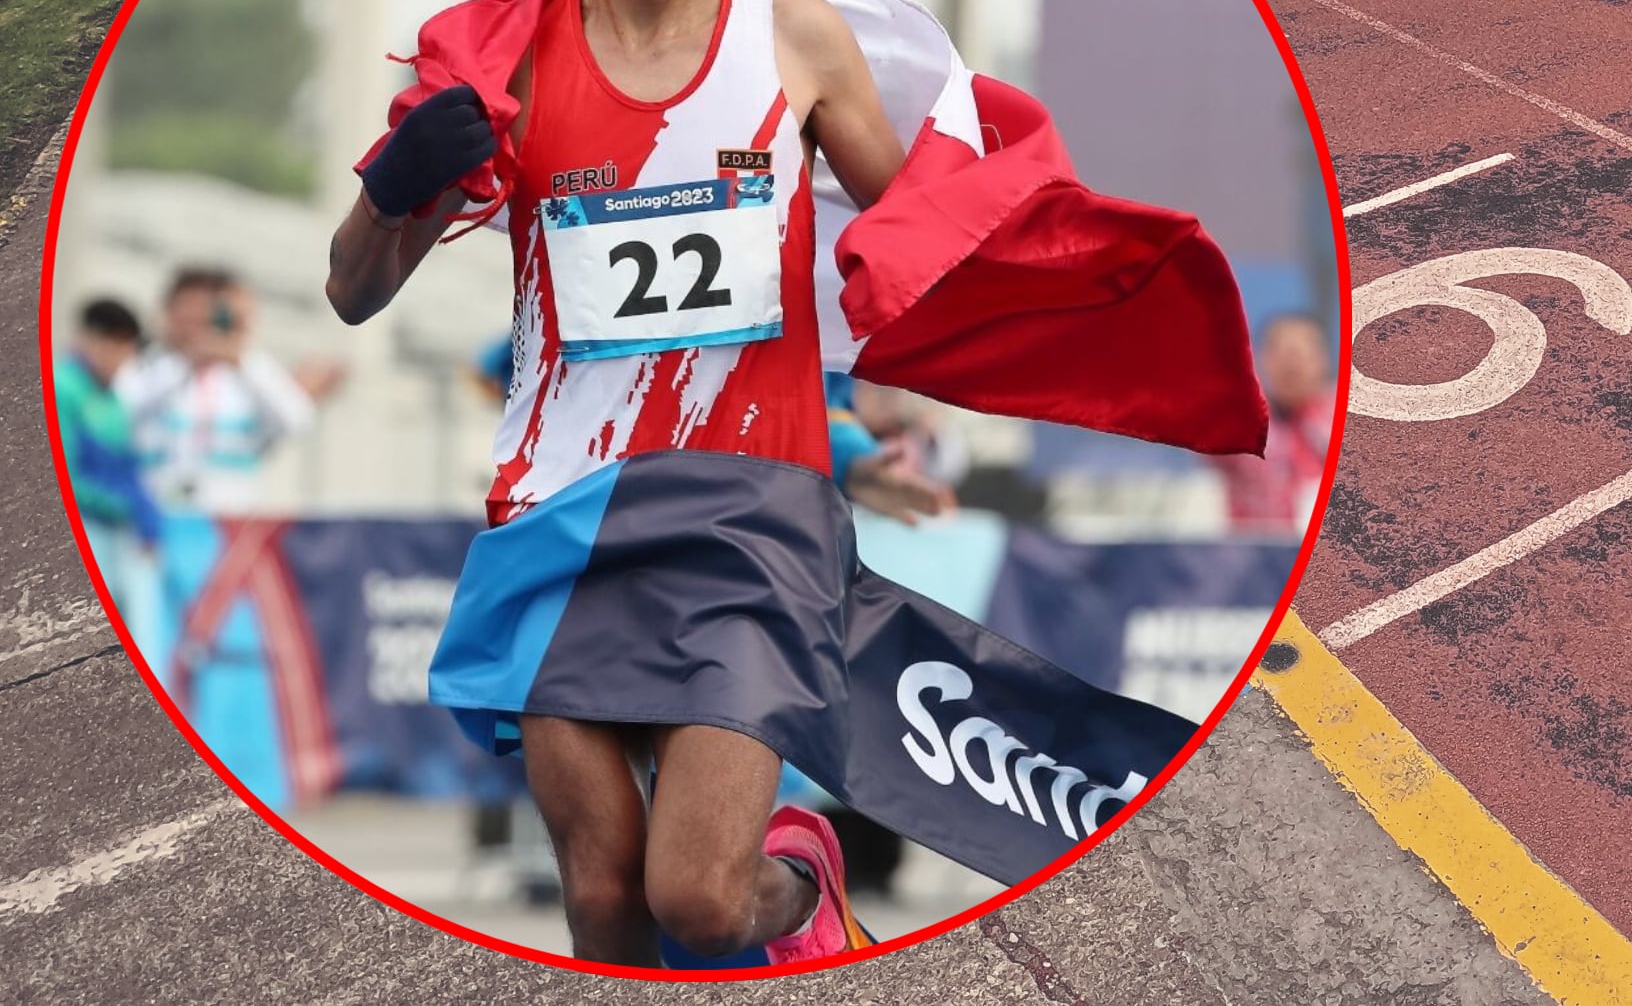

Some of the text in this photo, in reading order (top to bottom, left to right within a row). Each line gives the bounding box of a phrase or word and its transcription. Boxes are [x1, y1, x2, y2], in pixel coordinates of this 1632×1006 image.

[721, 153, 769, 167] F.D.P.A.
[552, 160, 617, 196] PERÚ
[605, 187, 714, 212] Santiago 2023
[608, 232, 732, 319] 22
